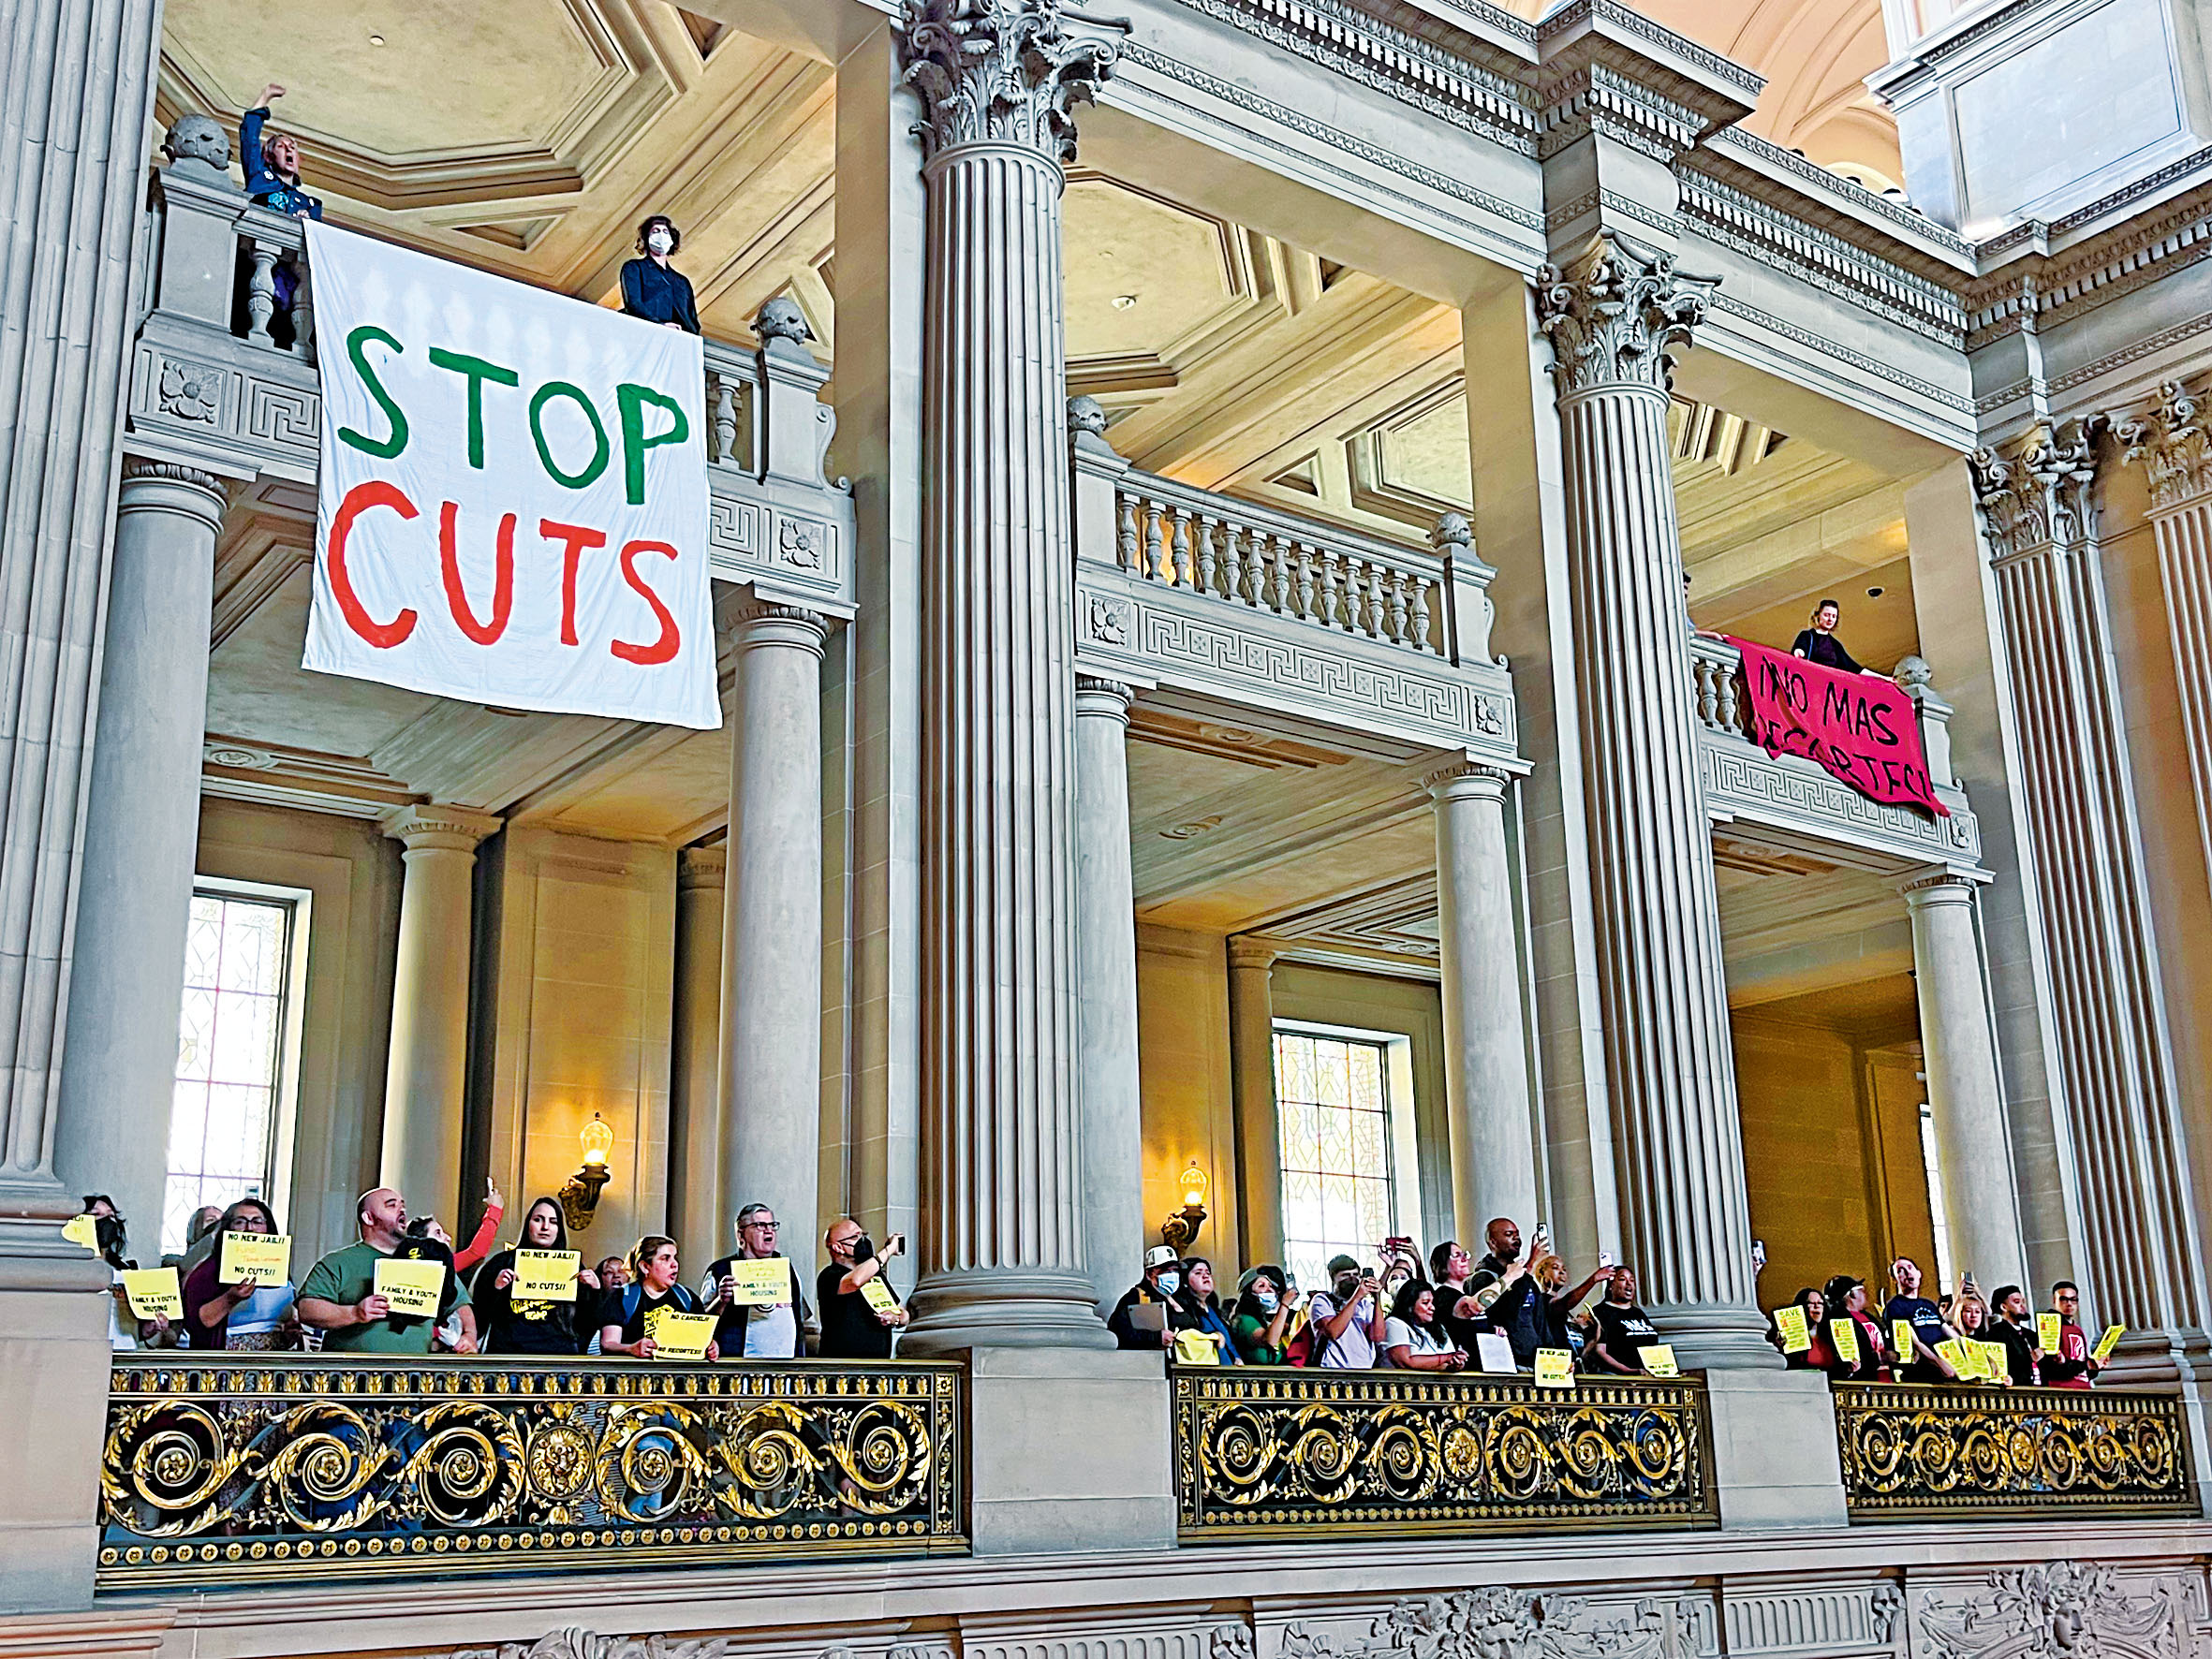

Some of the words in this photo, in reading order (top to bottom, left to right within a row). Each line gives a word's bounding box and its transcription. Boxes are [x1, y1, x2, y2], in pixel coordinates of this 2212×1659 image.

[338, 326, 688, 505] STOP
[328, 480, 680, 666] CUTS
[1823, 682, 1898, 745] MAS
[241, 1234, 258, 1242] NEW
[247, 1267, 276, 1276] CUTS!!
[381, 1285, 406, 1294] FAMILY
[538, 1283, 566, 1291] CUTS!!
[392, 1296, 424, 1306] HOUSING
[1778, 1308, 1800, 1318] SAVE
